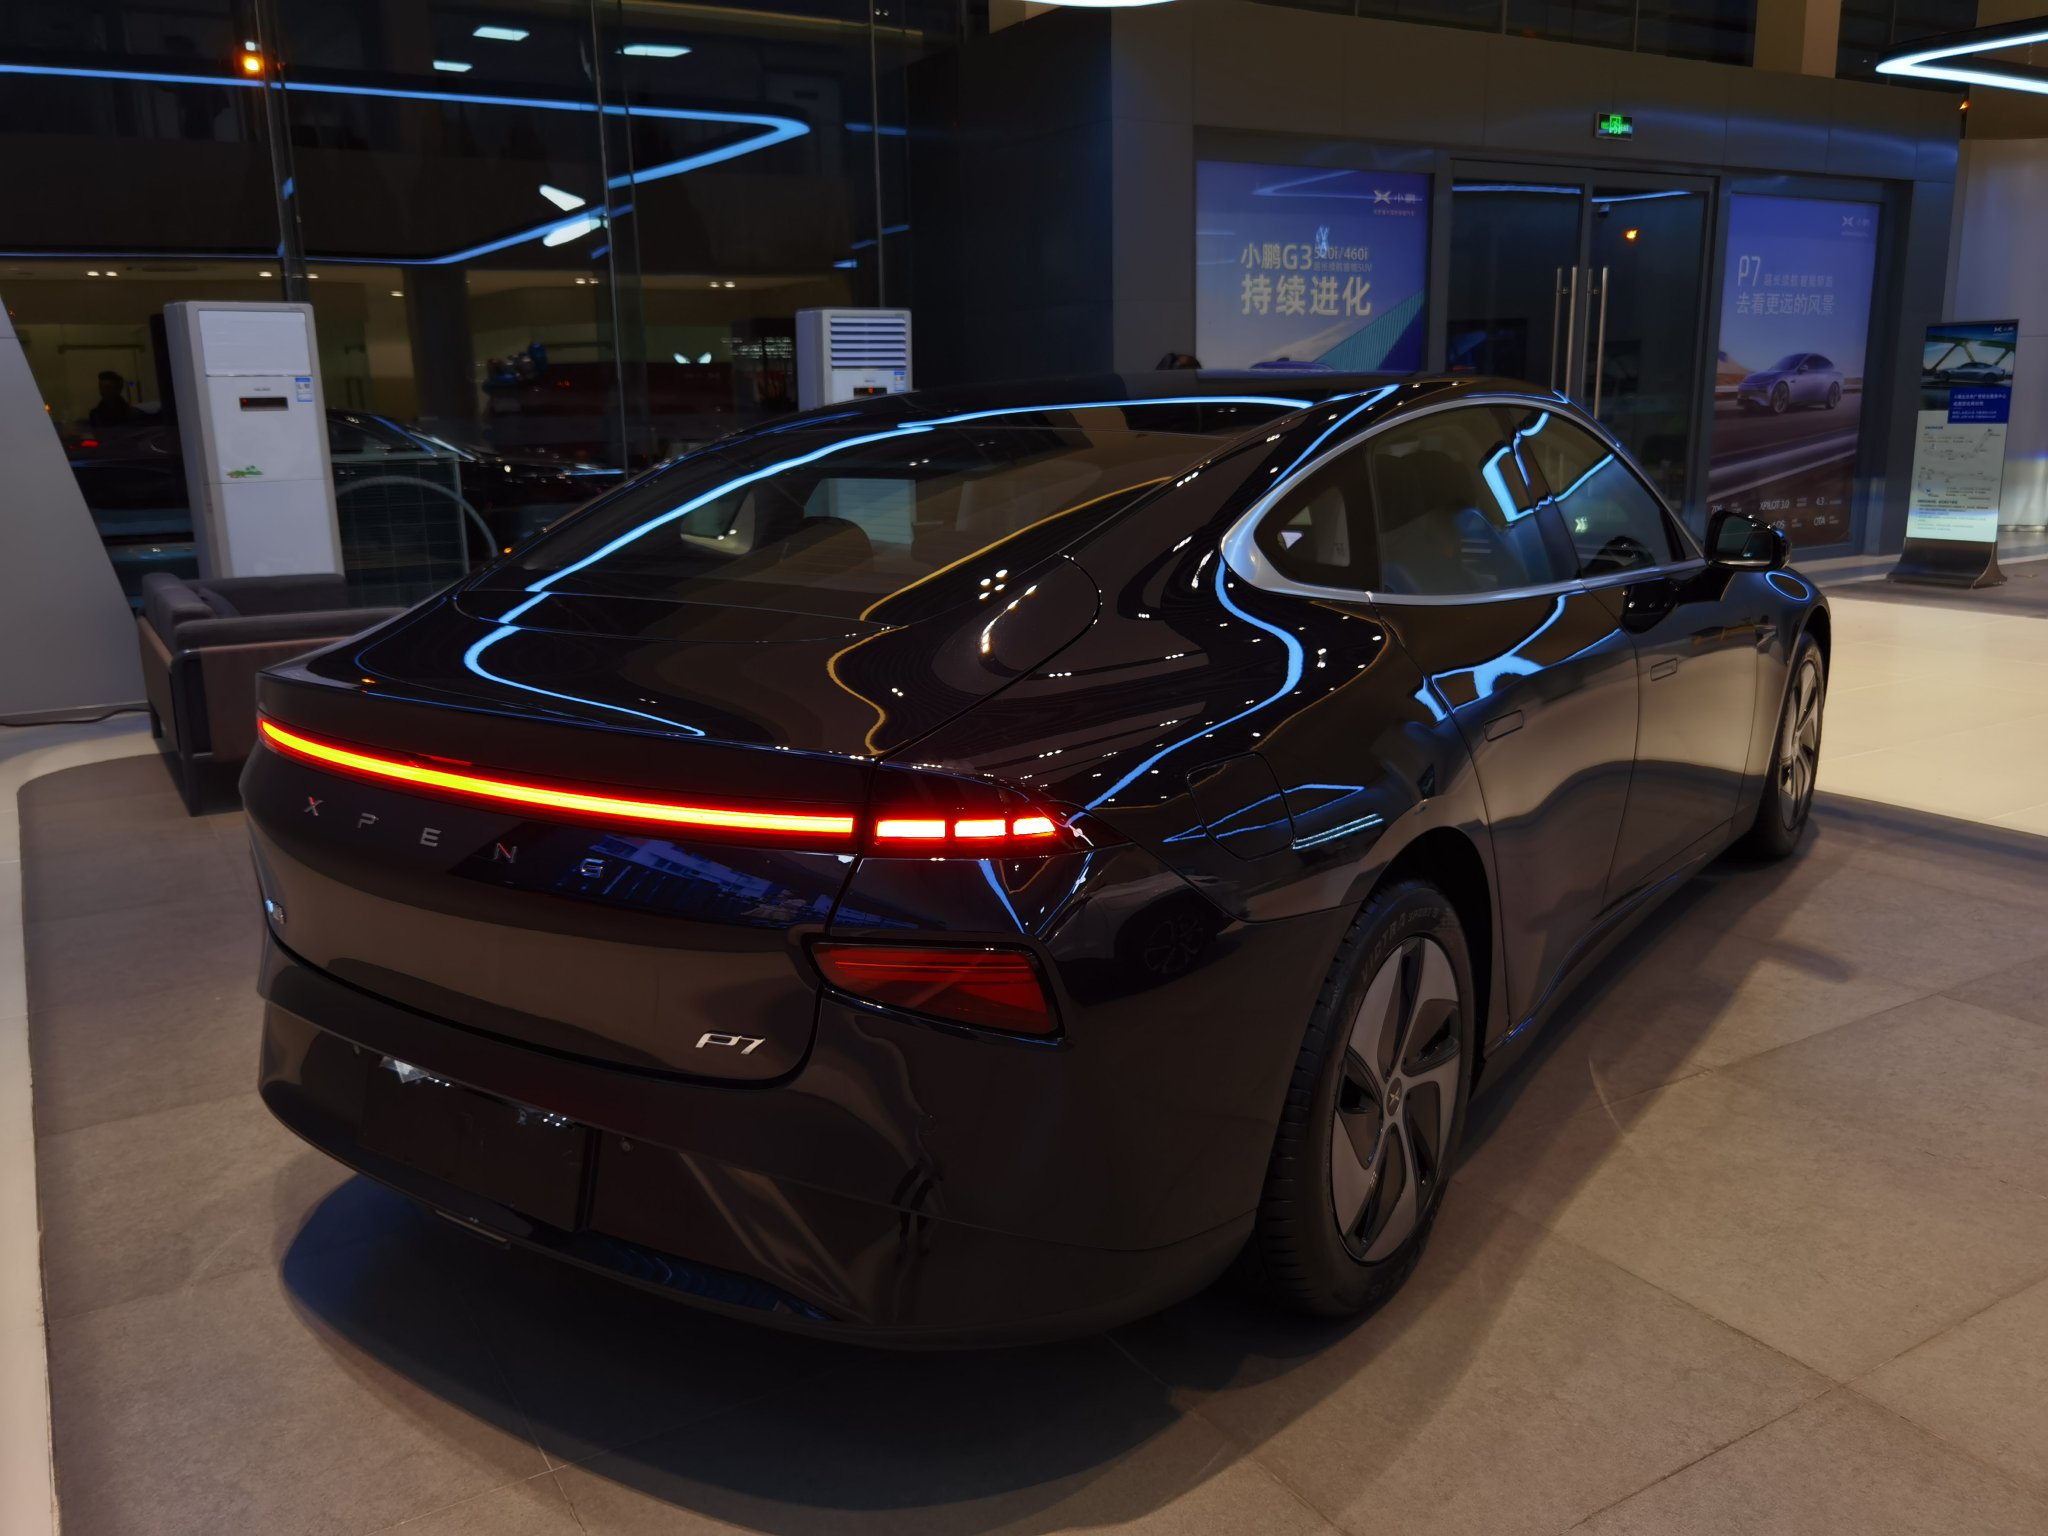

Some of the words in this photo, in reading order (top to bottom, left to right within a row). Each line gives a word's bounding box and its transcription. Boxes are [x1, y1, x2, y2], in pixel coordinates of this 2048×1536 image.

[1240, 243, 1313, 270] 小鹏G3
[1737, 255, 1761, 287] P7
[1240, 274, 1372, 317] 持续进化
[1736, 291, 1835, 316] 去看更远的风景
[304, 797, 605, 878] XPENG
[695, 1032, 766, 1055] P7
